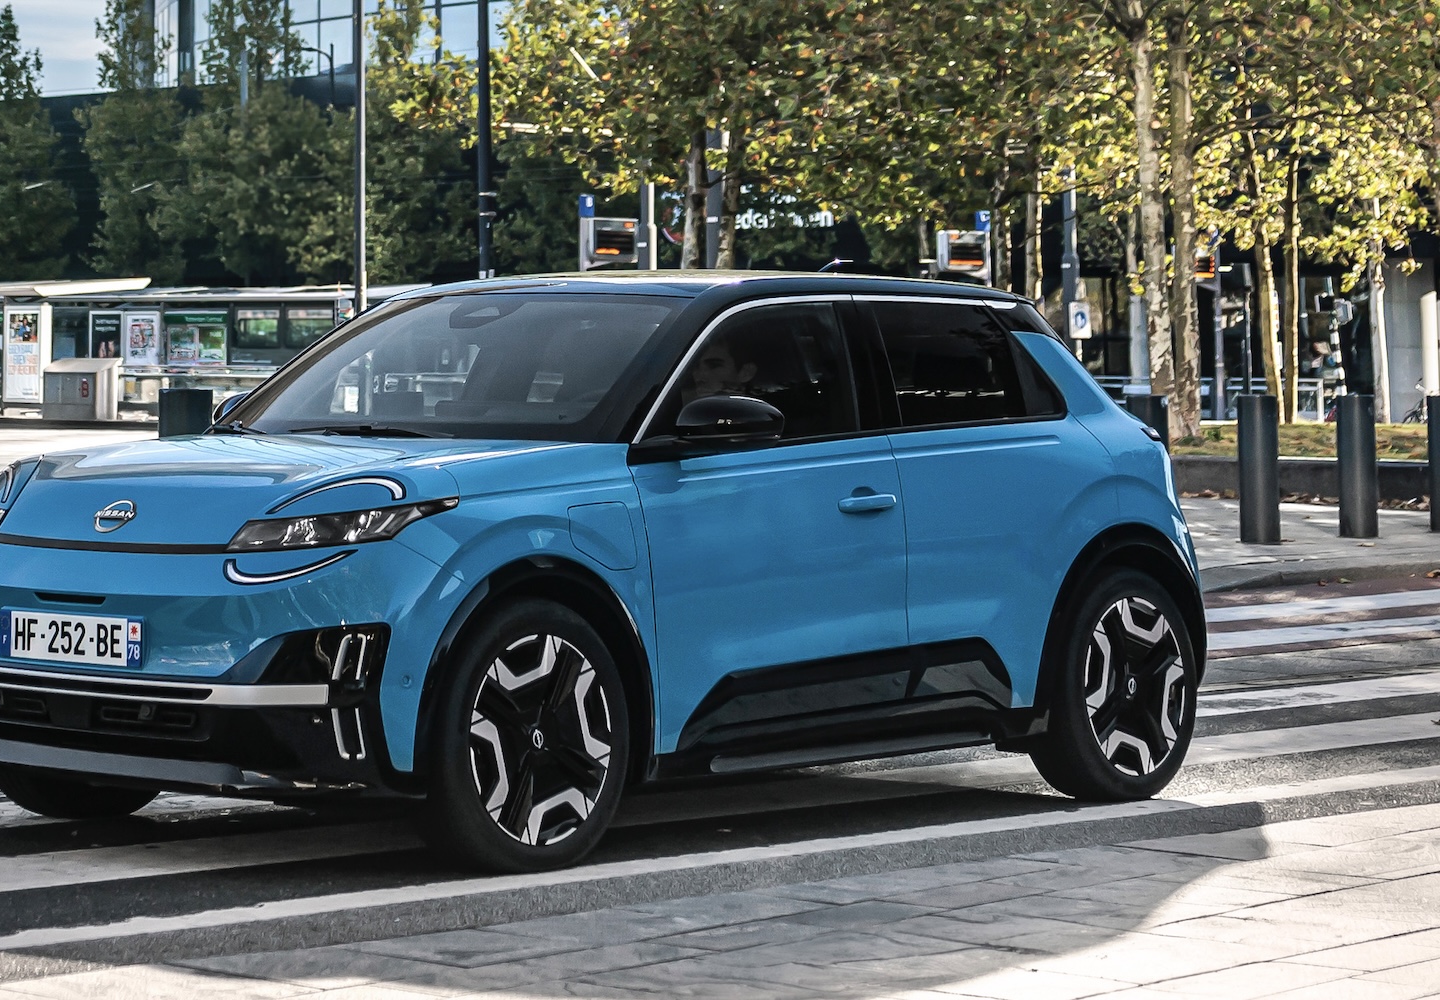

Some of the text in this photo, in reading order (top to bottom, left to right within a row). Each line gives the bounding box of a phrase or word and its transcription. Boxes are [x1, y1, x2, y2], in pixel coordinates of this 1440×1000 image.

[94, 509, 135, 519] NISSAN
[2, 634, 8, 645] F
[14, 617, 122, 659] HF-252-BE
[128, 643, 141, 660] 78
